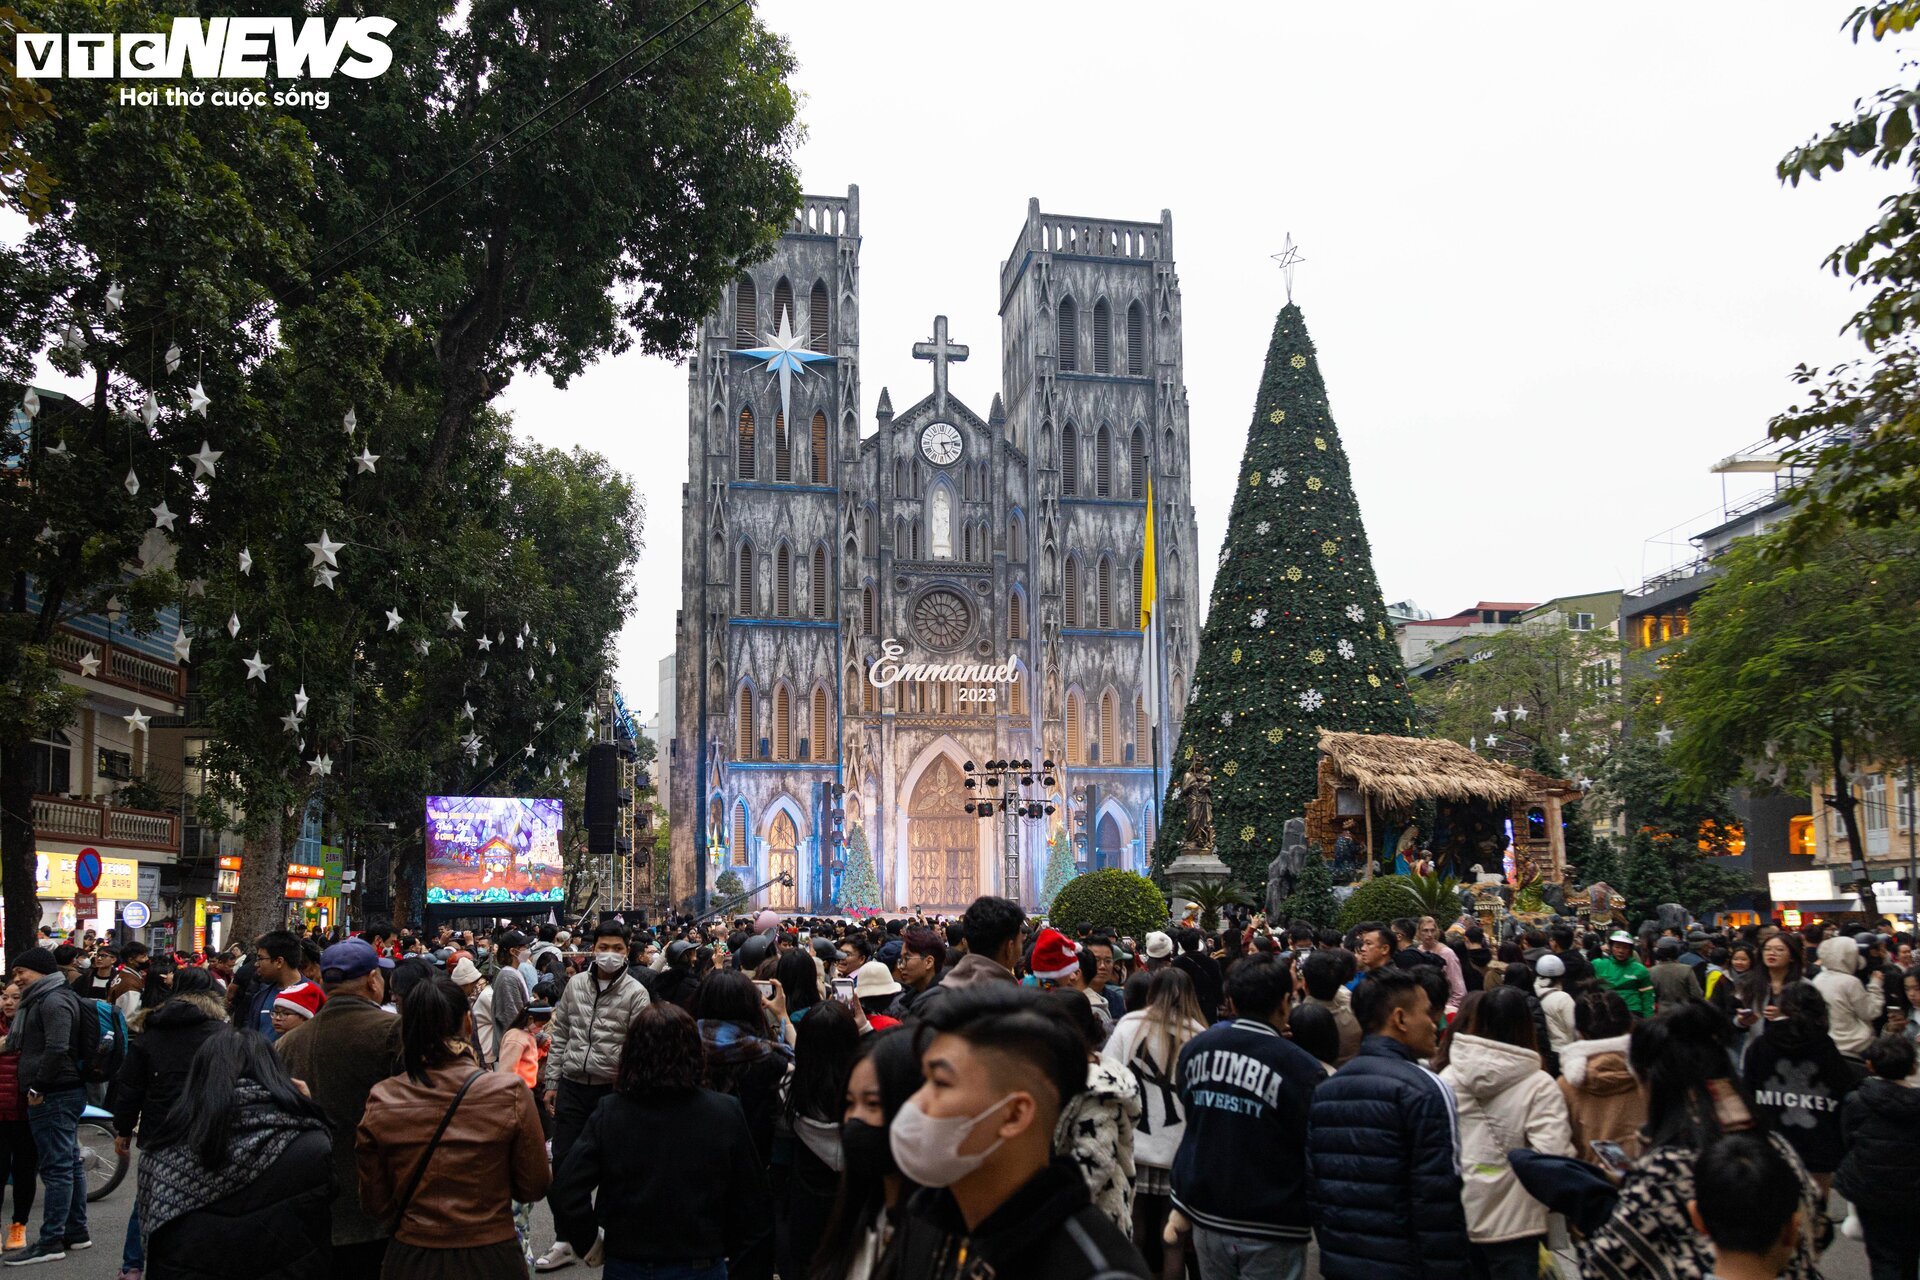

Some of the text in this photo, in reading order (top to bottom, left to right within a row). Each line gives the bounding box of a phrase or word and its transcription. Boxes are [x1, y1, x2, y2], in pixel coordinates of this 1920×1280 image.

[869, 638, 1019, 688] Emmanuel
[958, 688, 996, 702] 2023
[1185, 1049, 1283, 1110] COLUMBIA
[1755, 1089, 1839, 1112] MICKEY
